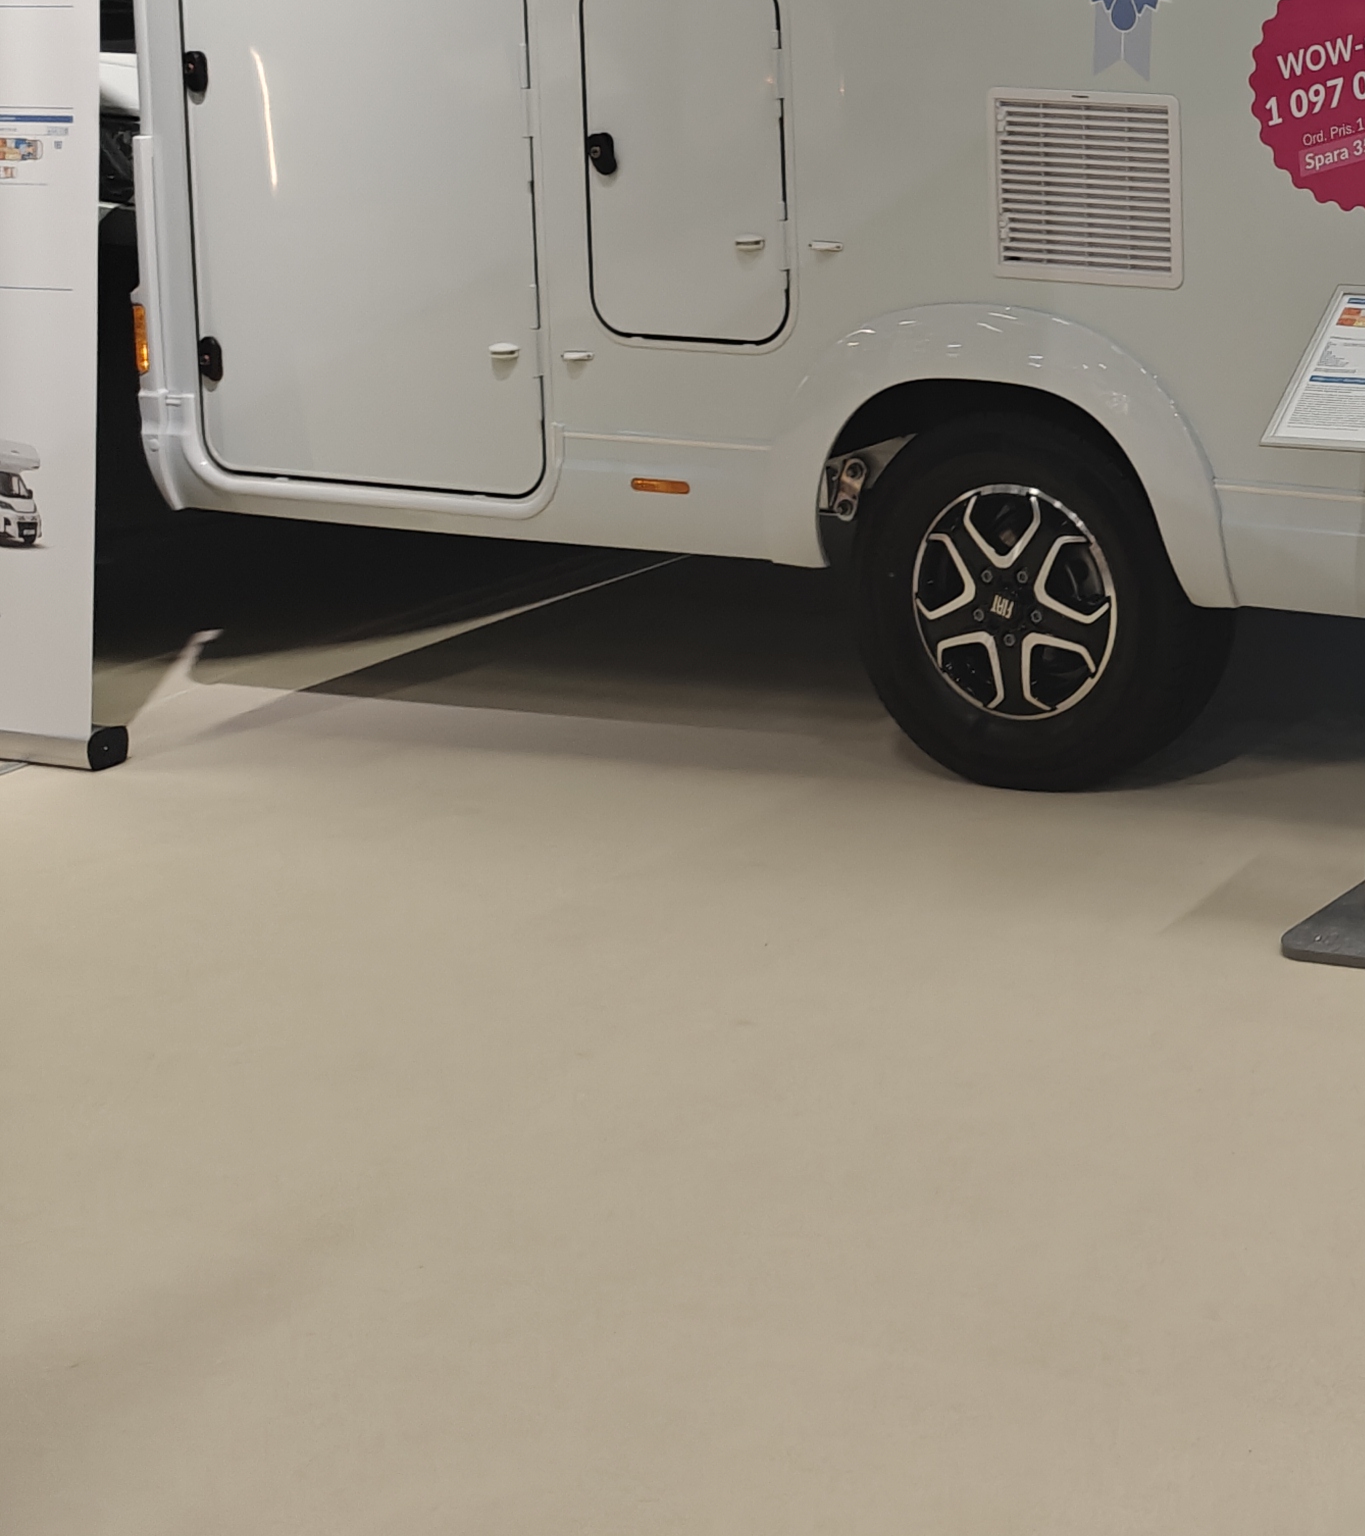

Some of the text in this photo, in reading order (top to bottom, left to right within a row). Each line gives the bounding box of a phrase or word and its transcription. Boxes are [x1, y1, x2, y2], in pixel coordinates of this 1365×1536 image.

[1265, 96, 1283, 126] 1
[1289, 77, 1344, 118] 097
[1303, 130, 1327, 146] Ord.
[1330, 124, 1355, 139] Pris.
[1356, 117, 1365, 131] 1
[1304, 147, 1349, 171] Spara
[990, 594, 1015, 619] FIAT
